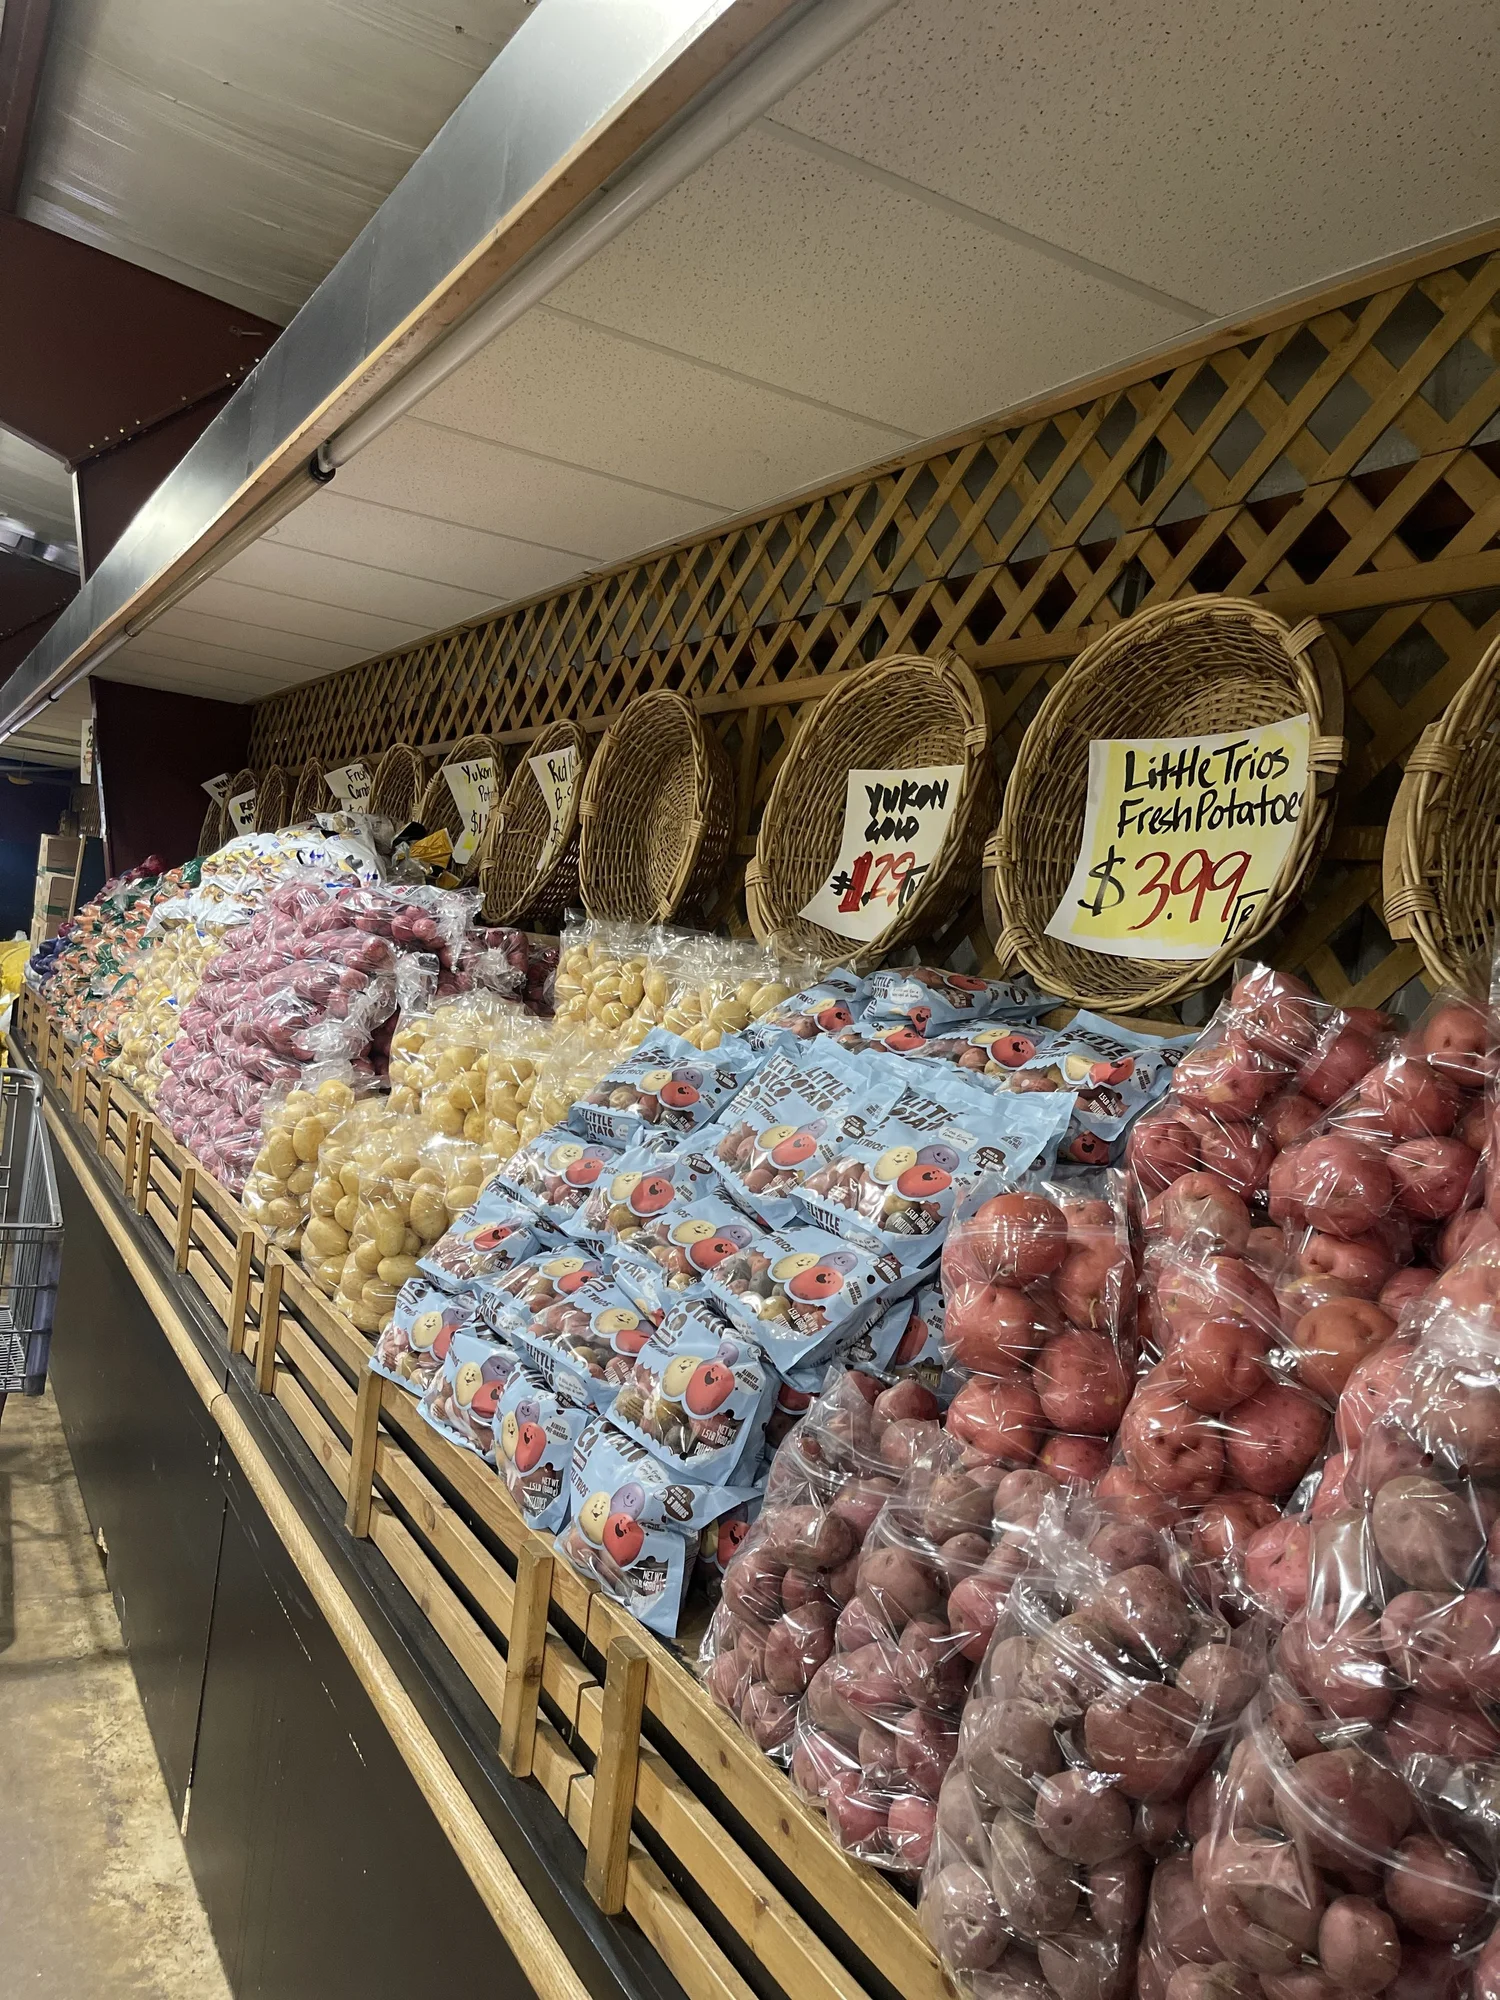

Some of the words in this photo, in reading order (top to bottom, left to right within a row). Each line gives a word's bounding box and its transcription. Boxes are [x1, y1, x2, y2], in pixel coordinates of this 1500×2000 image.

[461, 764, 492, 784] Yukon
[1125, 746, 1214, 793] Little
[1212, 739, 1290, 785] Trios
[864, 779, 949, 819] YUKON
[1117, 796, 1191, 838] Fresh
[1195, 784, 1304, 833] Potatoe
[864, 816, 920, 845] GOLD
[585, 1112, 613, 1128] LiTTLE
[811, 1203, 840, 1231] LiTTLE
[772, 1233, 793, 1252] TRIOS
[623, 1261, 647, 1282] TATO
[529, 1346, 555, 1371] LiTTLE
[735, 1371, 759, 1391] PRE-WASHED
[742, 1369, 759, 1383] ALWAYS
[574, 1476, 589, 1497] TRIOS
